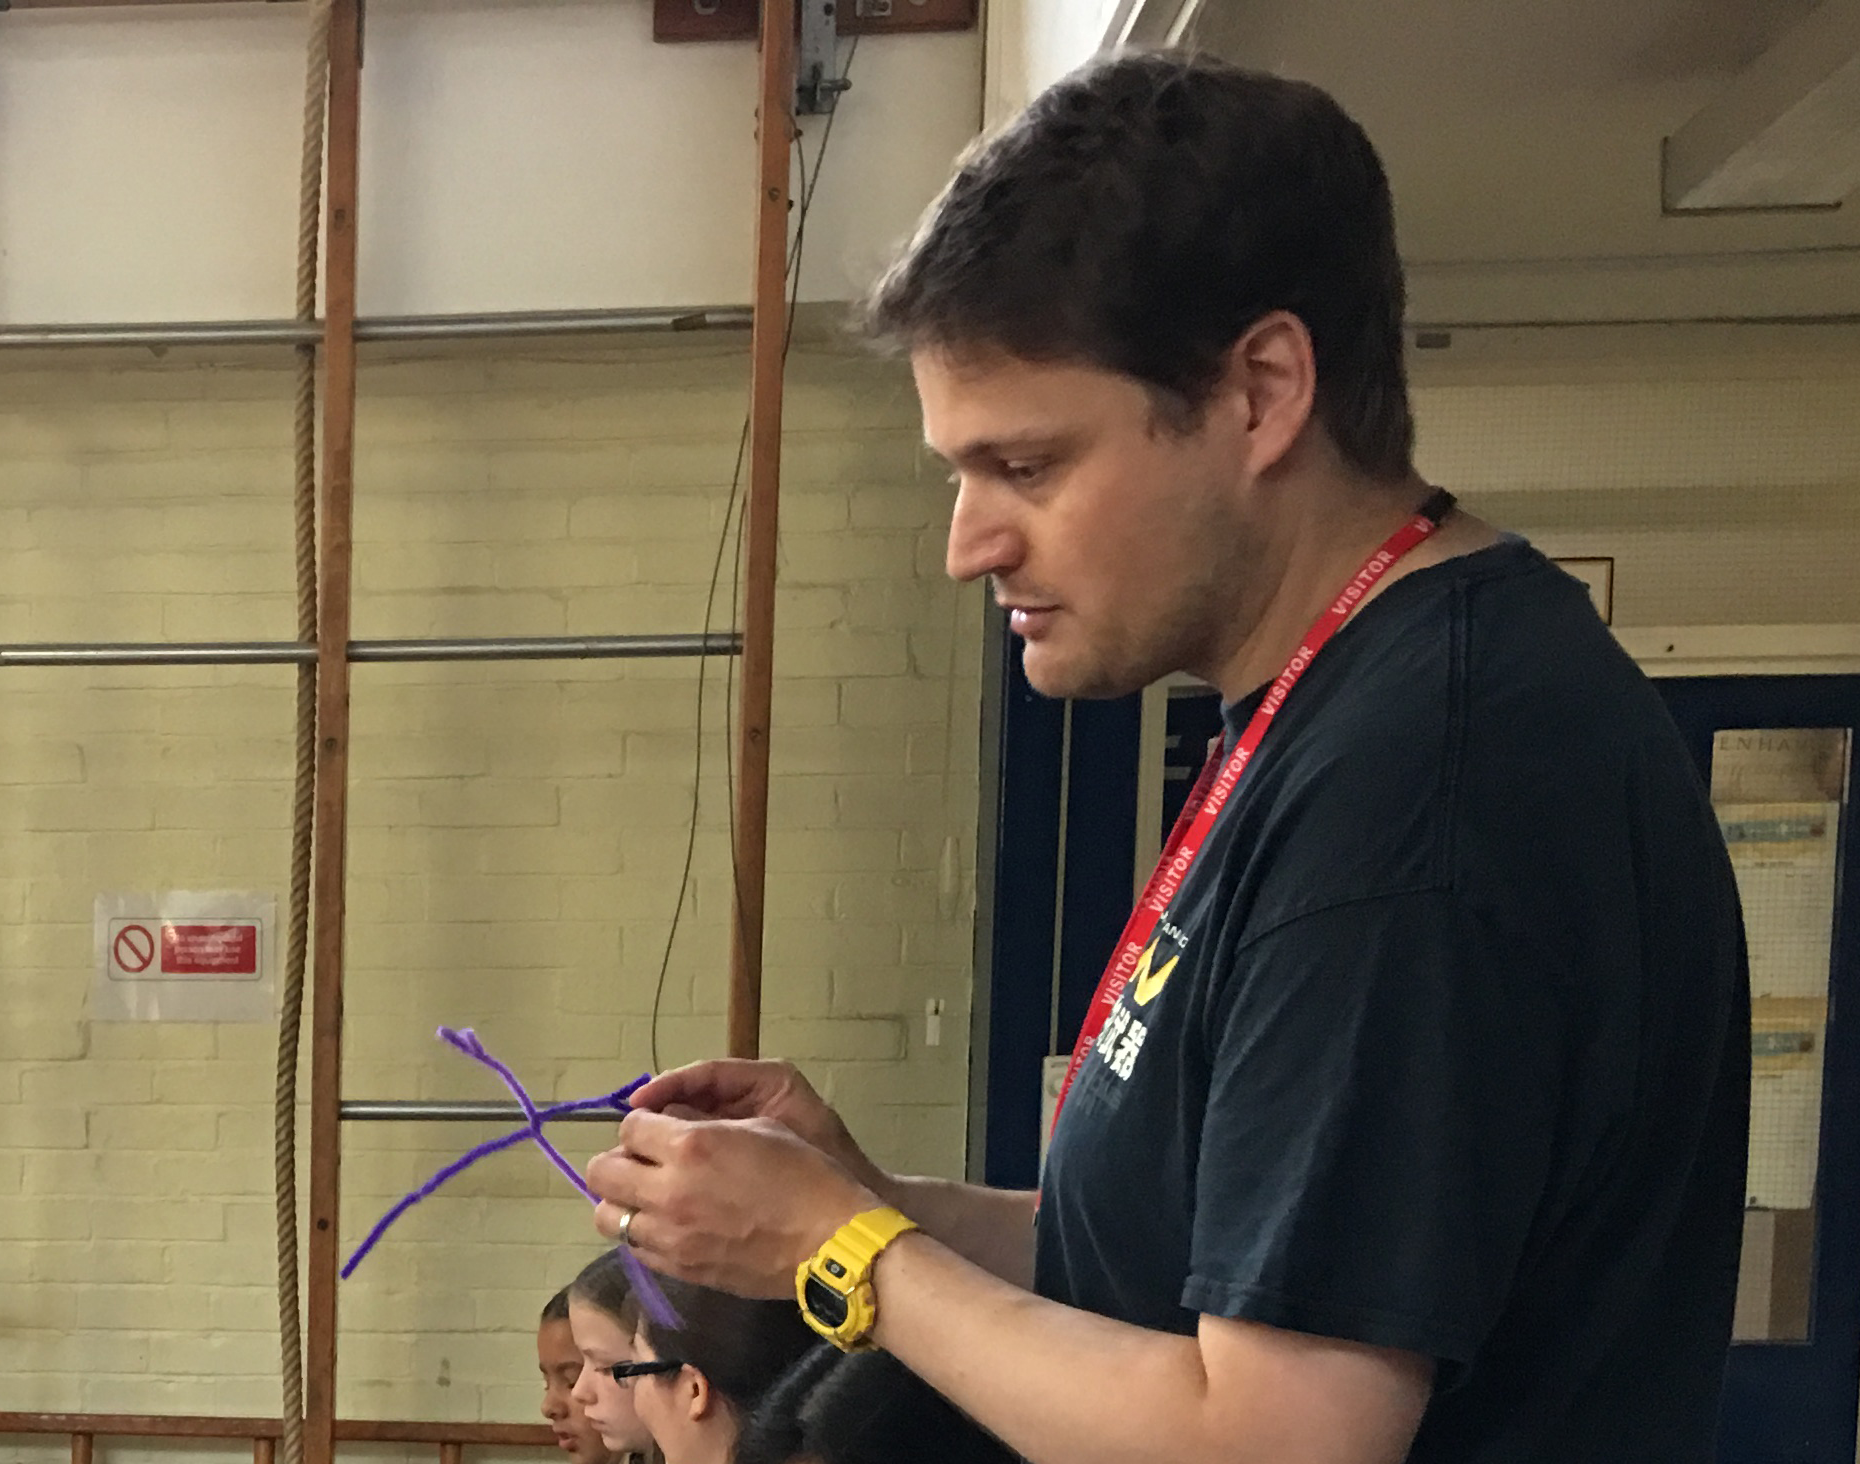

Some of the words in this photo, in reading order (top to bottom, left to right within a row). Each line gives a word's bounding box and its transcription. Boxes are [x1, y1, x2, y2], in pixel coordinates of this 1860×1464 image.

[1332, 550, 1394, 614] VISITOR
[1261, 646, 1314, 716] VISITOR
[1204, 747, 1250, 815] VISITOR
[1148, 846, 1194, 913] VISITOR
[1101, 942, 1143, 1005] VISITOR
